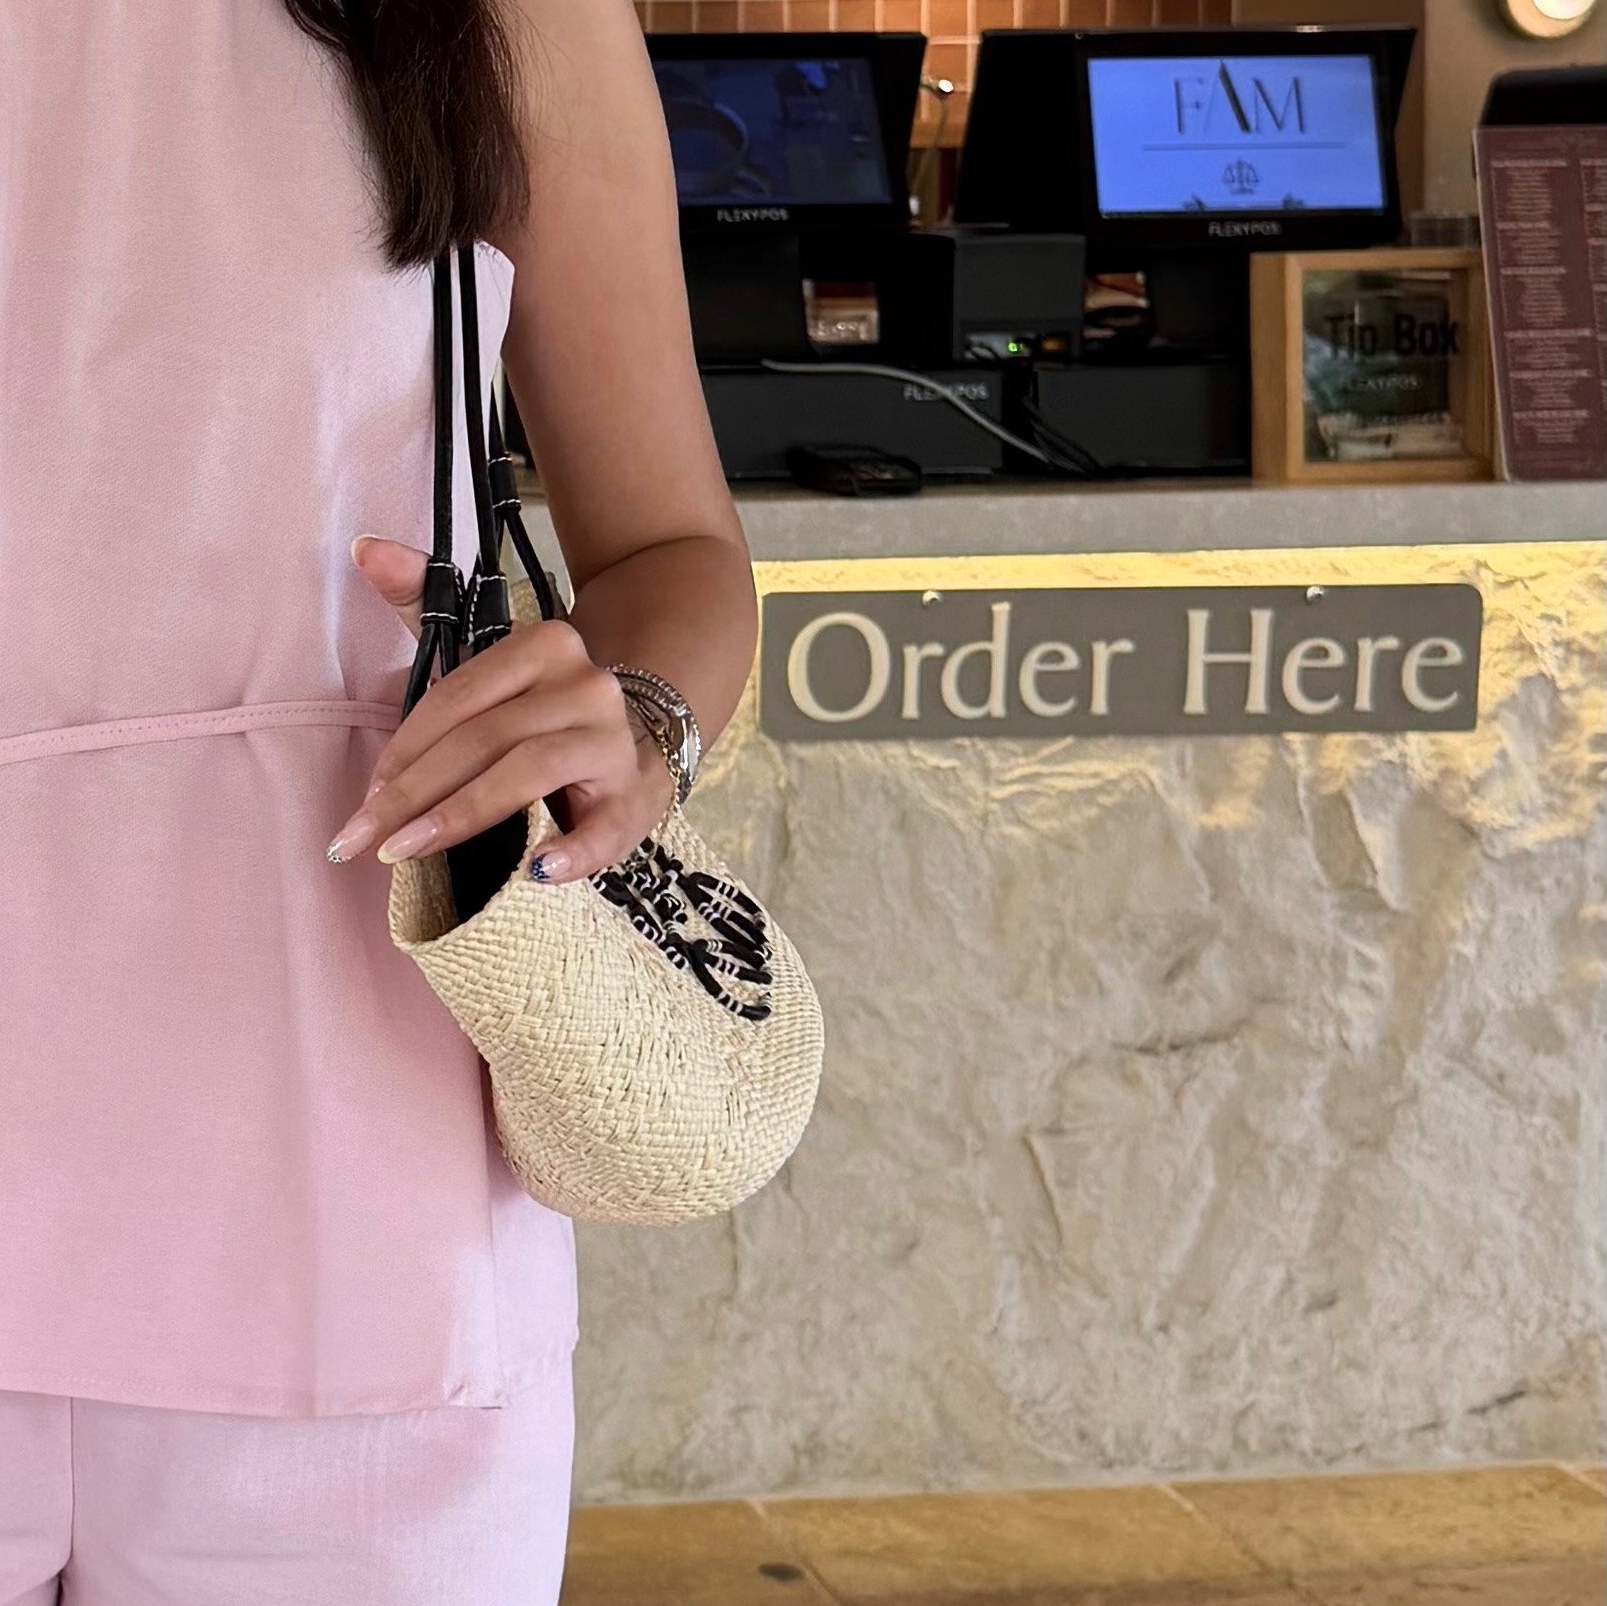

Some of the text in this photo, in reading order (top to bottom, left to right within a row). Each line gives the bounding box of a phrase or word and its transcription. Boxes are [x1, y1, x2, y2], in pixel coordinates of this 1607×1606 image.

[1172, 59, 1306, 135] FAM
[715, 207, 790, 224] FLEXYPOS
[1395, 312, 1459, 356] Box
[903, 382, 990, 402] FLEPOS
[785, 601, 1466, 722] Order Here
